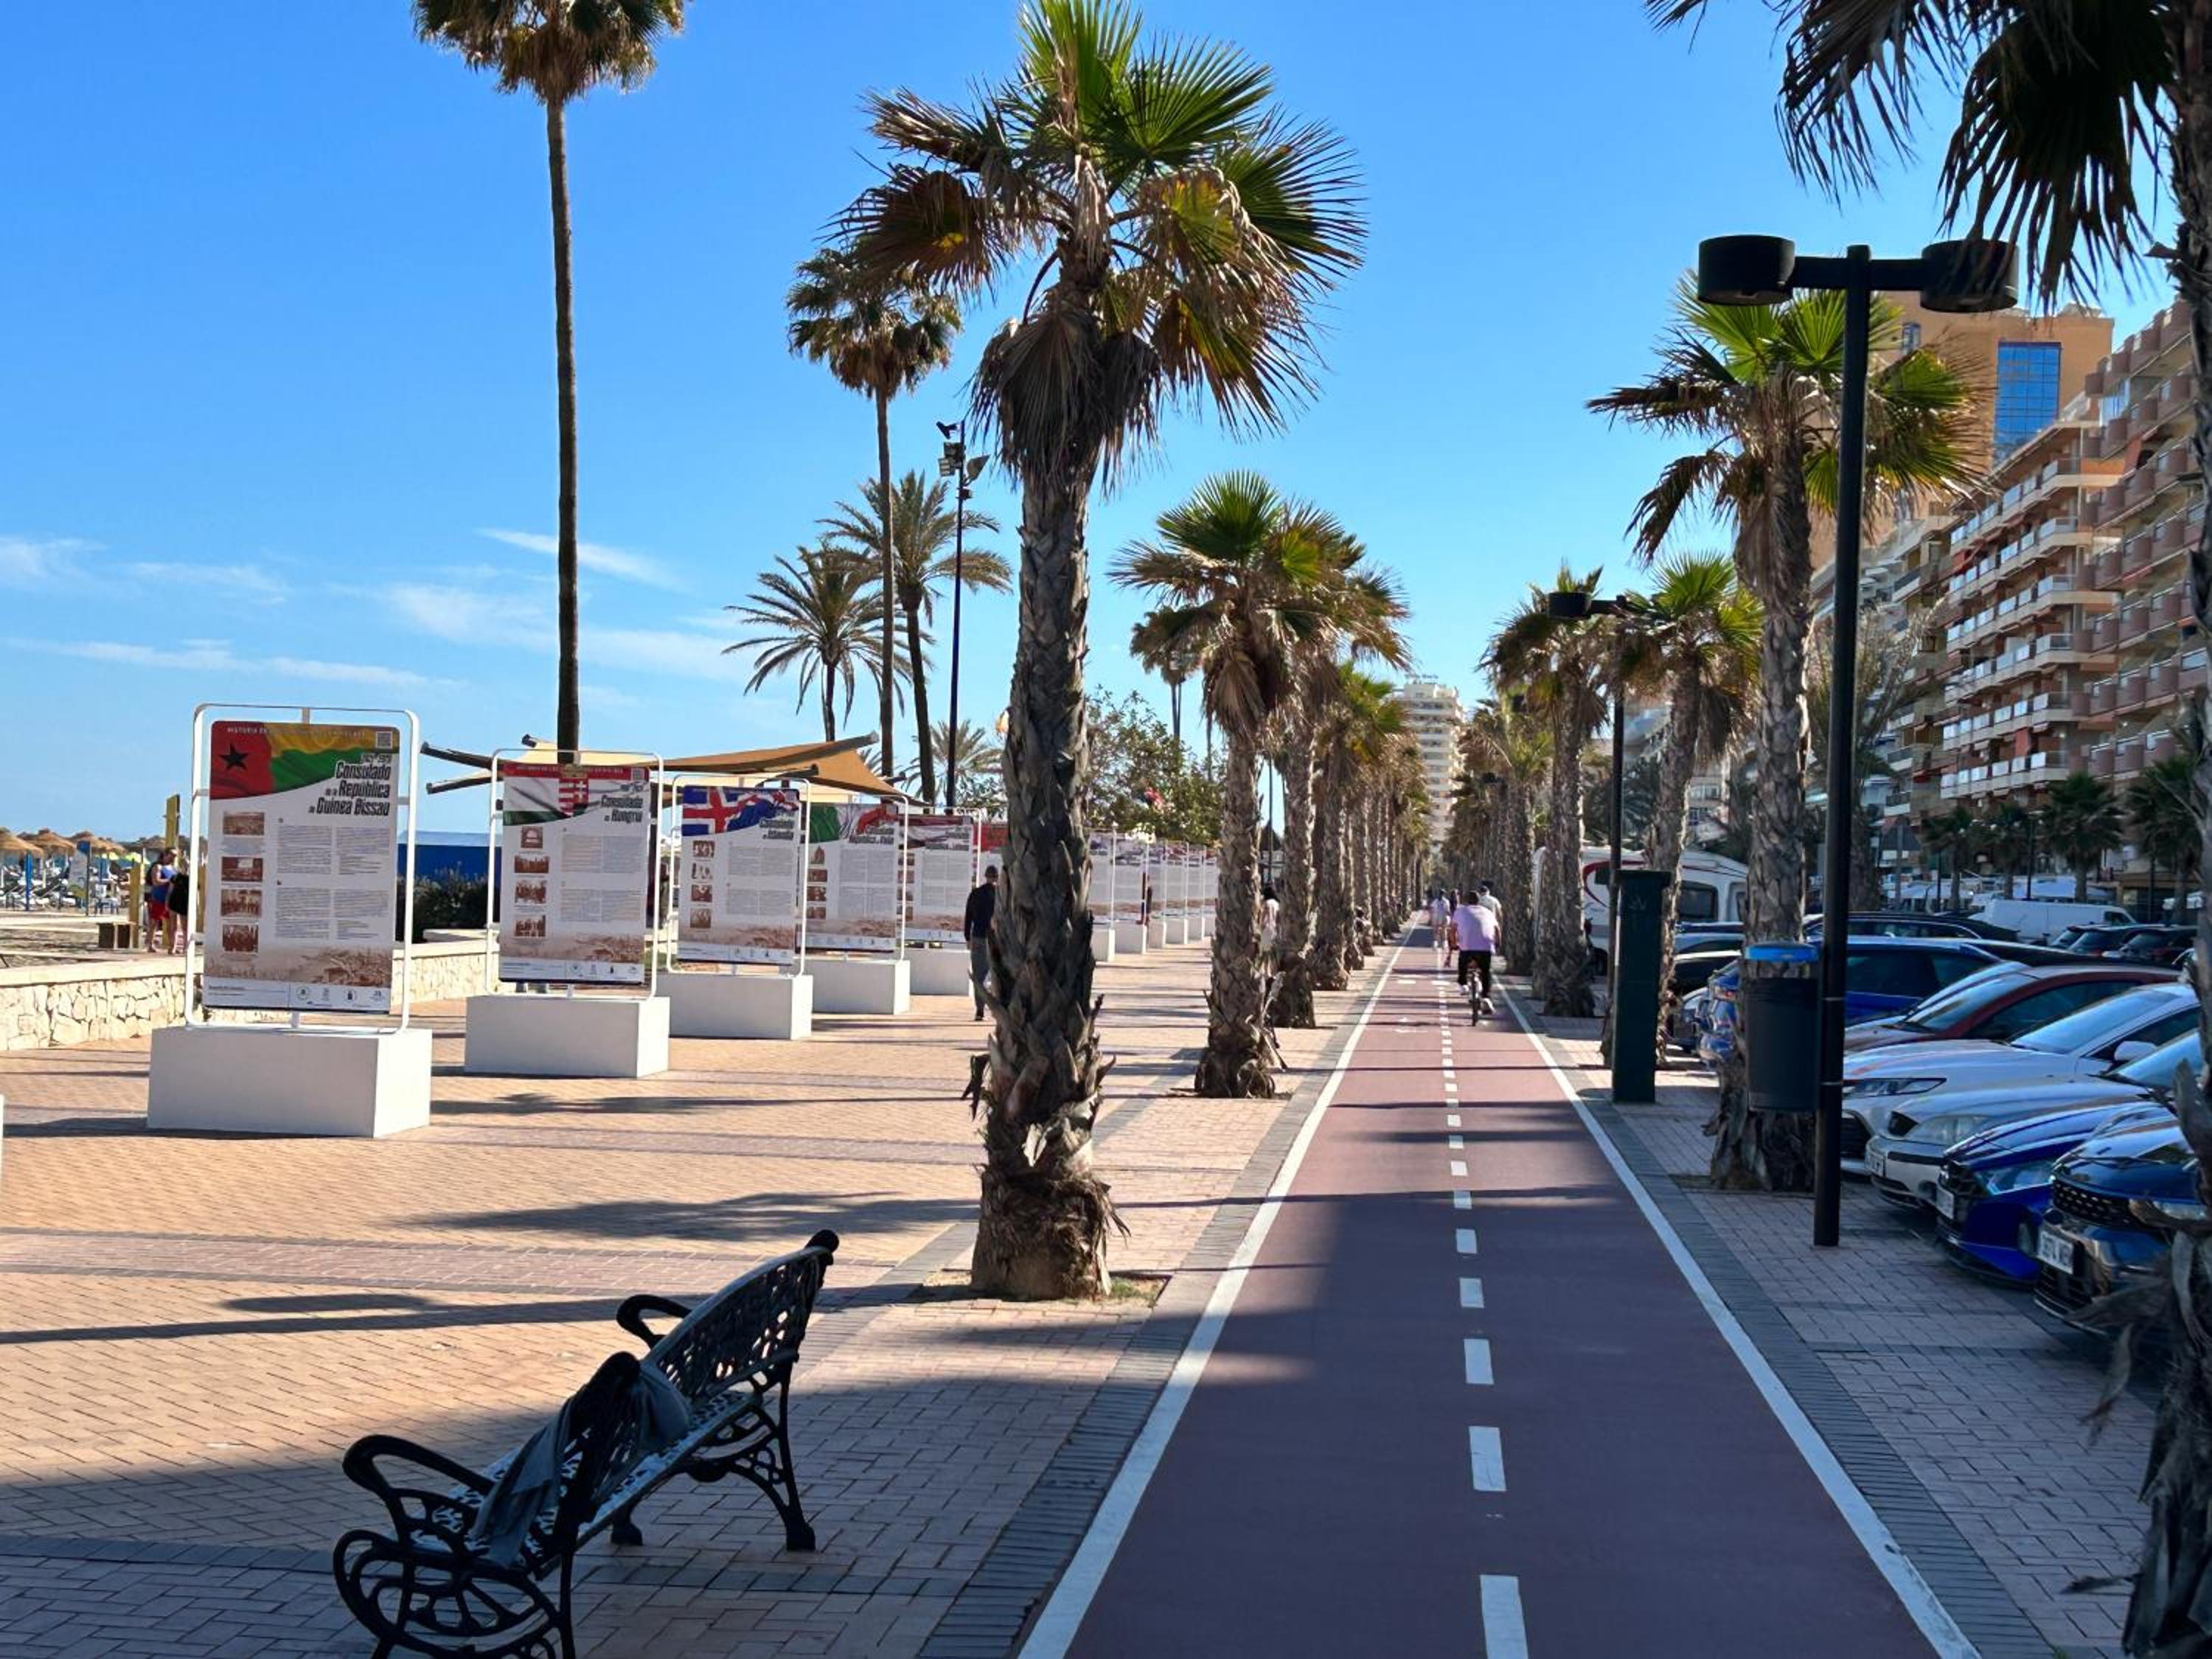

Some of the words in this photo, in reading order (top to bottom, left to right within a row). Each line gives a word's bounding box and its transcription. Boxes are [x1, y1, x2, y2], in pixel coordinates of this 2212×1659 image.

[336, 761, 392, 780] Consulado
[338, 779, 391, 799] República
[316, 796, 353, 815] Guinea
[354, 798, 391, 816] Bissau
